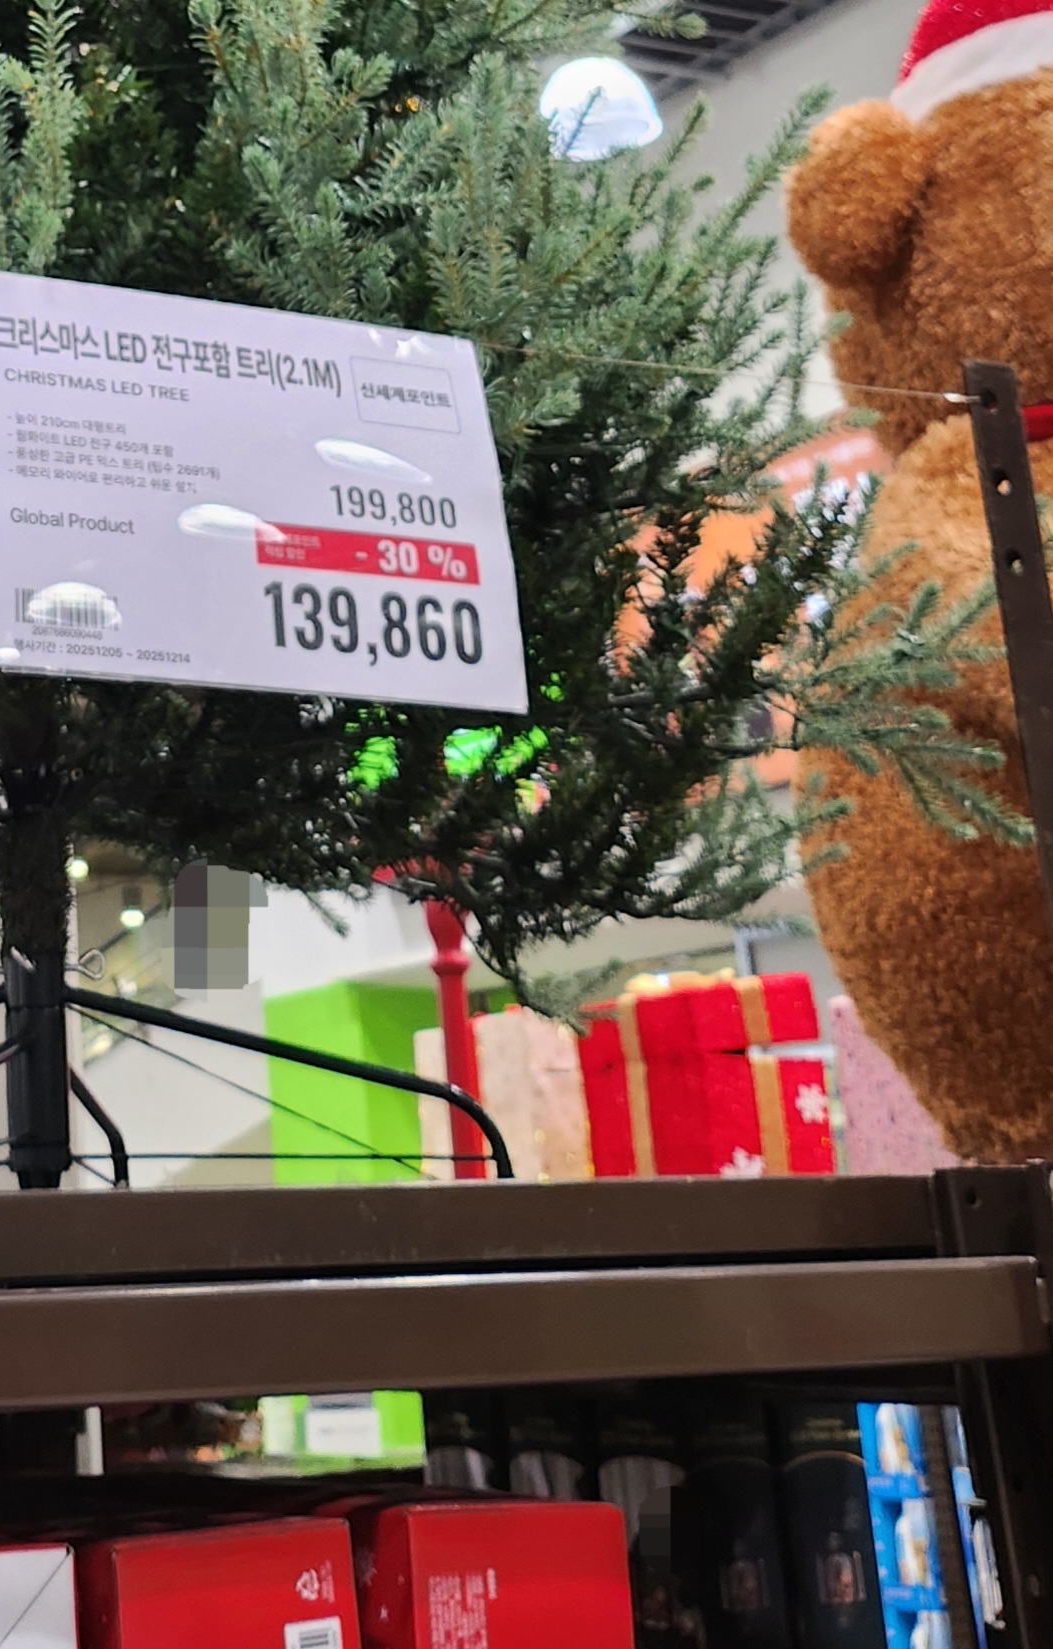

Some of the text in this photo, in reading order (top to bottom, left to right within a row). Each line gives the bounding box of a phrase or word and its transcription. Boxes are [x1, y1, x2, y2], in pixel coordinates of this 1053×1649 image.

[104, 330, 148, 364] LED
[150, 333, 232, 380] 전구포함
[235, 347, 342, 399] 트리(2.1M)
[4, 367, 191, 403] CHRISTMAS LED TREE
[360, 381, 453, 408] 신세계포인트
[41, 415, 81, 431] 210cm
[63, 434, 88, 448] LED
[90, 437, 112, 452] 전구
[115, 440, 150, 456] 450개
[53, 451, 76, 465] 고급
[78, 453, 94, 466] PE
[122, 457, 145, 471] 트리
[16, 464, 51, 480] 메모리
[53, 468, 99, 484] 와이어로
[102, 472, 146, 489] 편리하고
[10, 506, 136, 535] Global Product
[329, 484, 458, 529] 199,800
[377, 538, 420, 575] 30
[427, 544, 468, 581] %
[263, 580, 483, 667] 139,860
[13, 638, 57, 654] 행사기간
[65, 642, 124, 659] 20251205
[135, 648, 192, 664] 20251214
